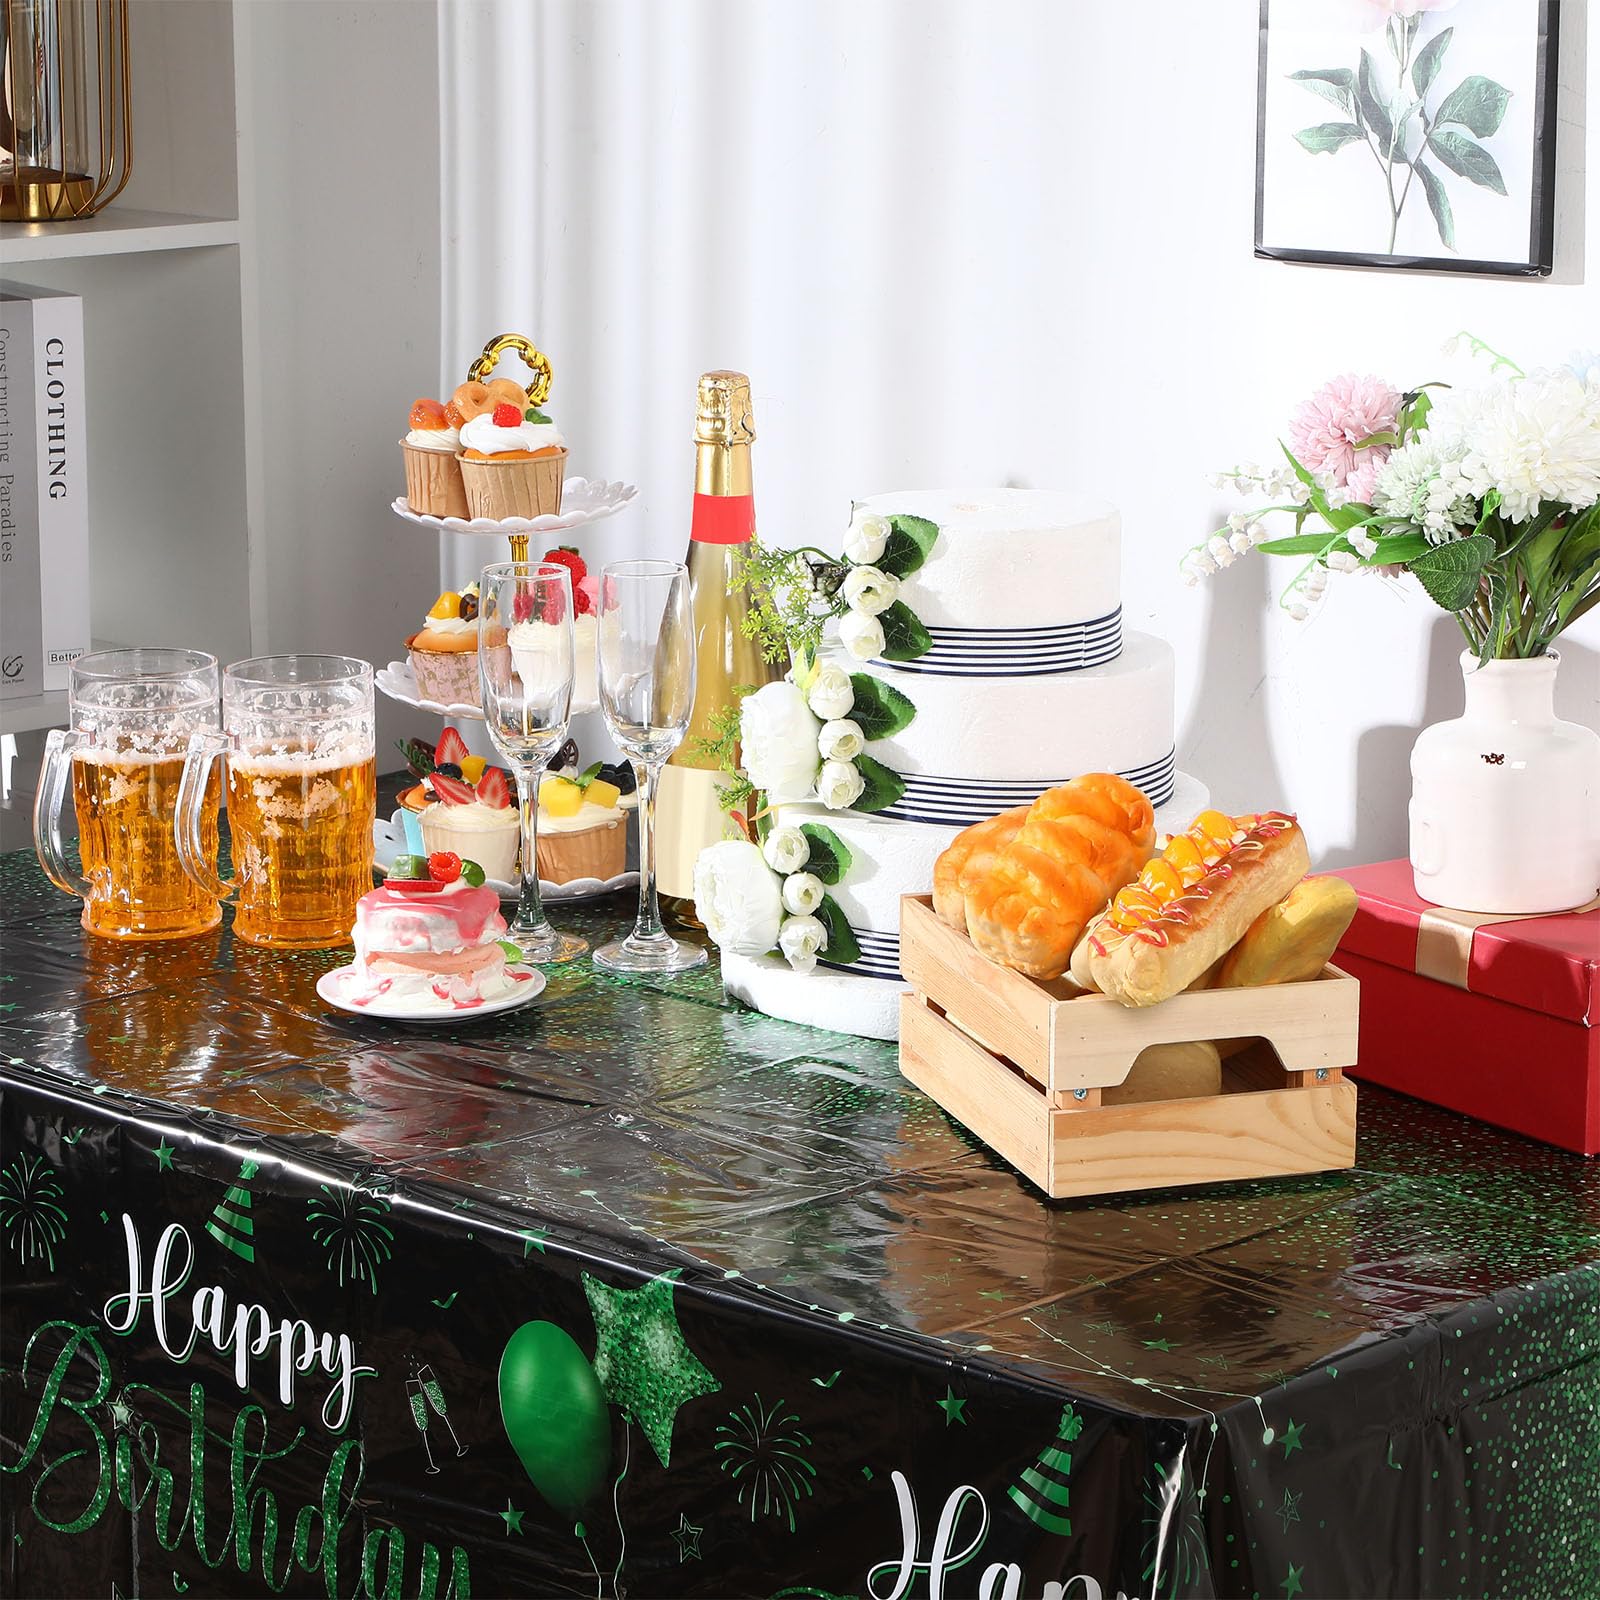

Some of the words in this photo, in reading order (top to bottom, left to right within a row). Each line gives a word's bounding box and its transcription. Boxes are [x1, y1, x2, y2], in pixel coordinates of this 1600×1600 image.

[46, 338, 67, 500] CLOTHING
[0, 473, 16, 562] Paradies
[104, 1213, 378, 1434] Happy
